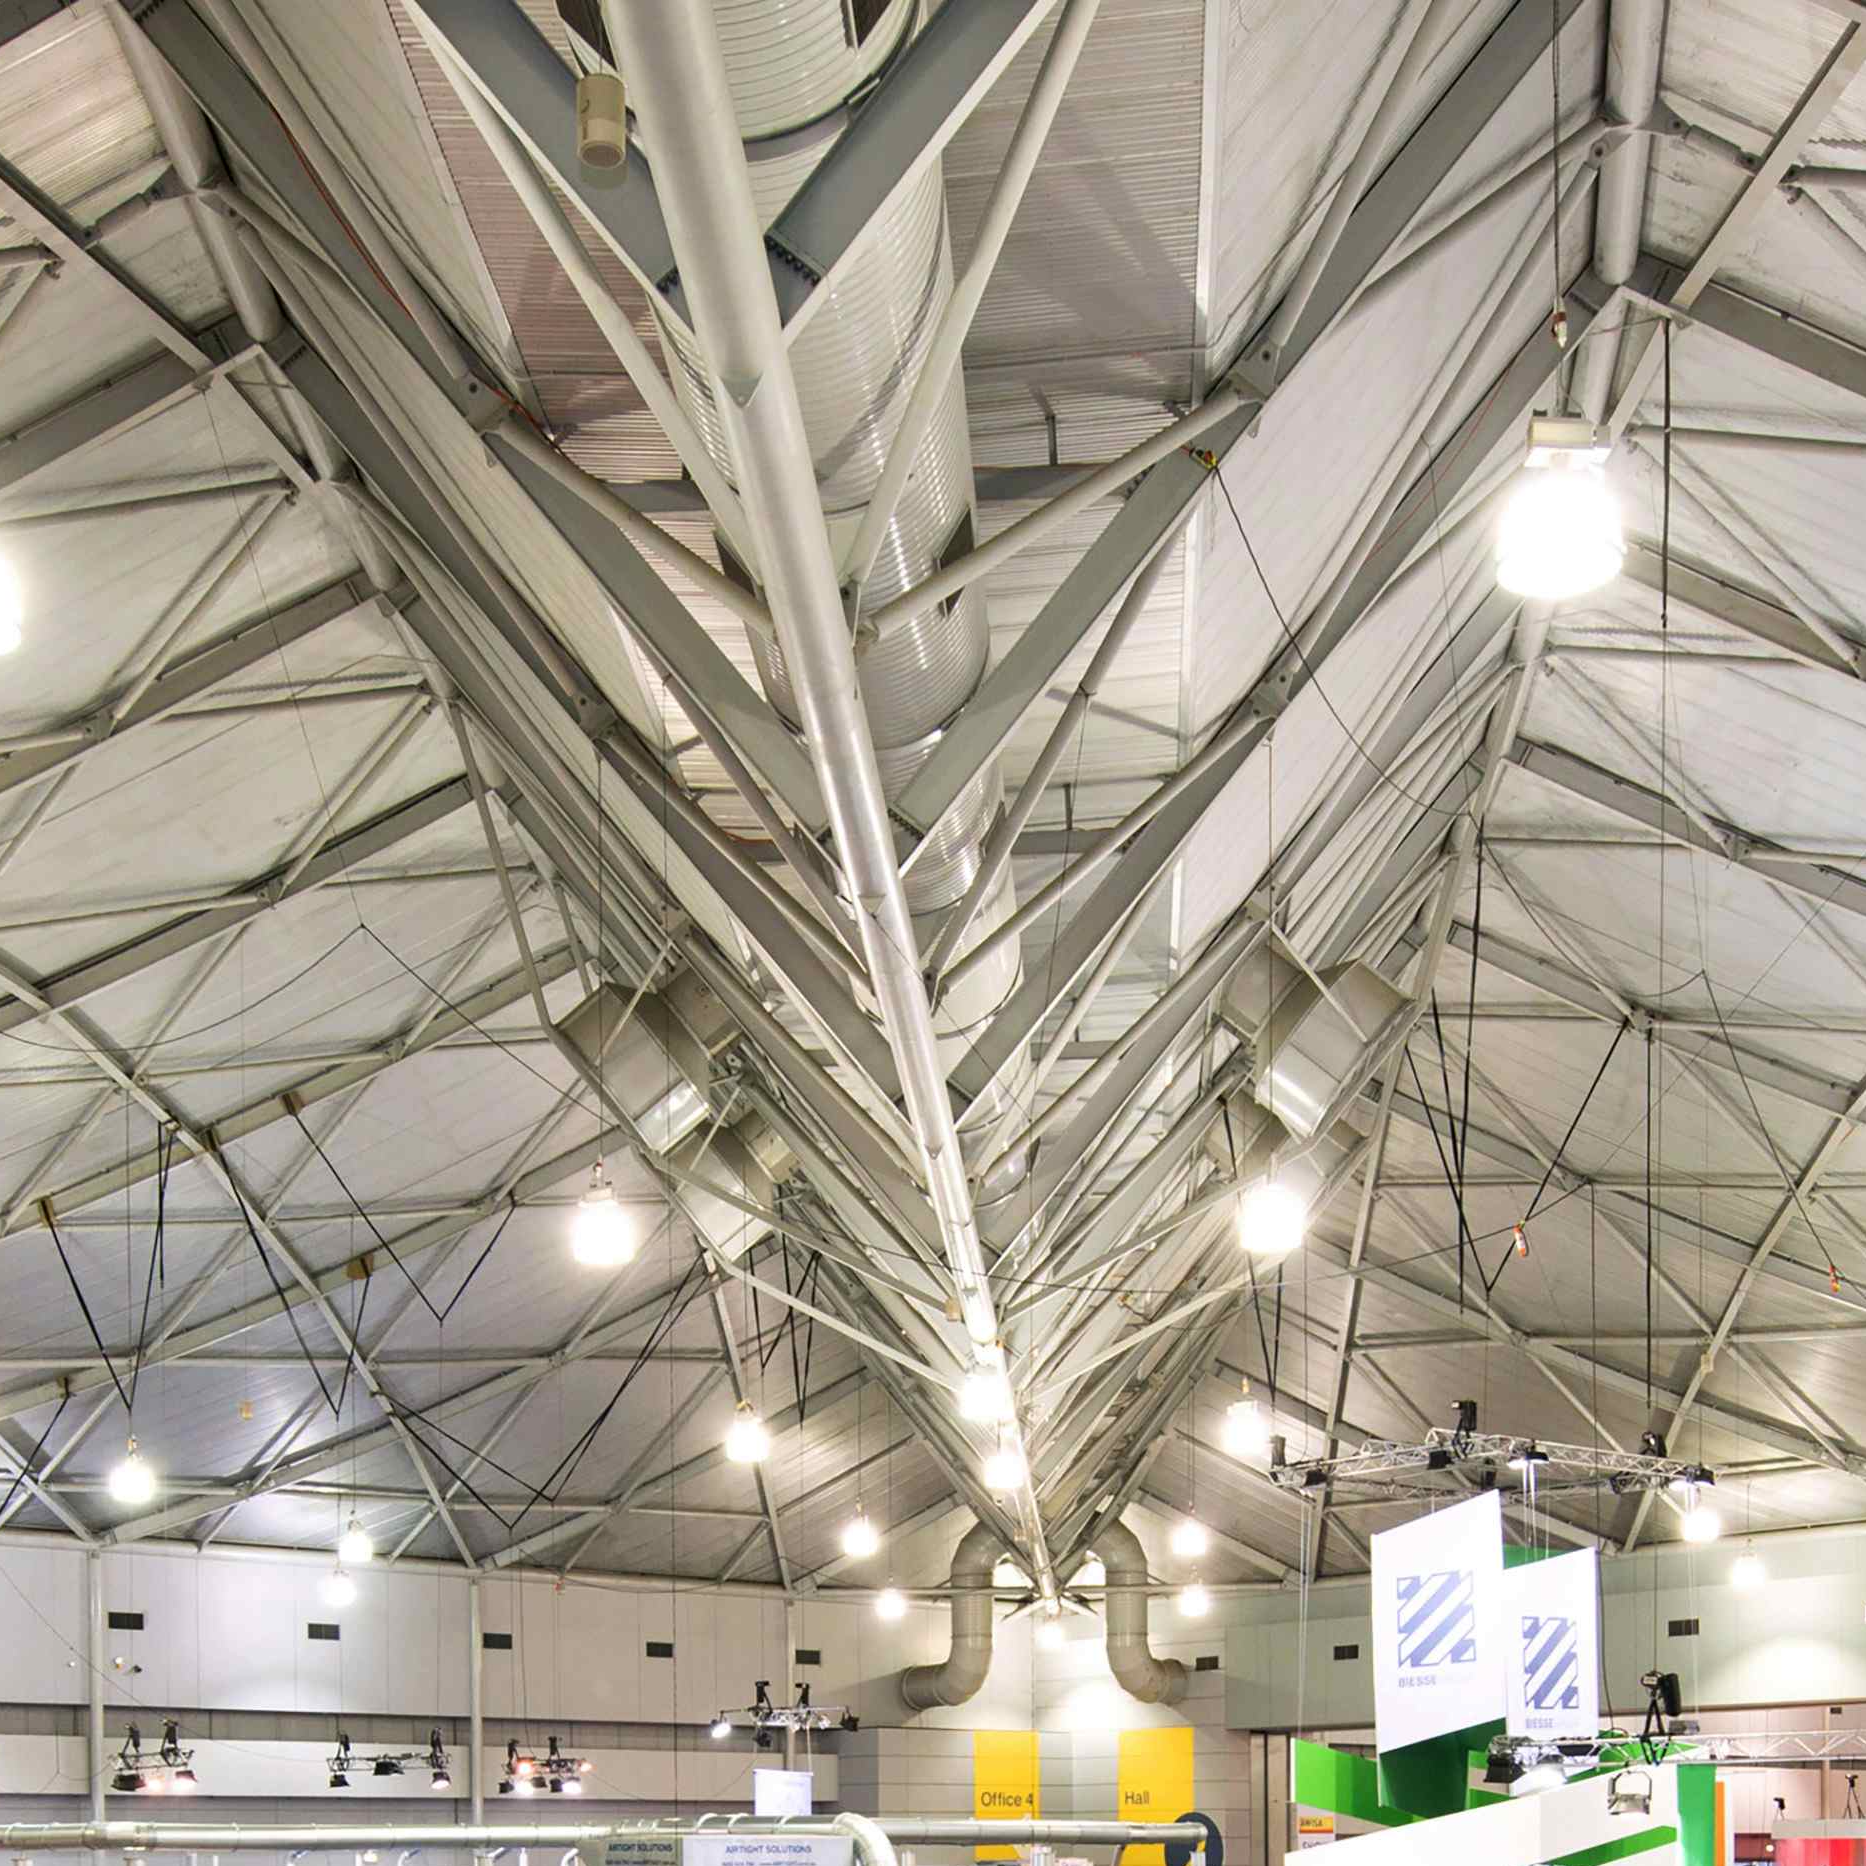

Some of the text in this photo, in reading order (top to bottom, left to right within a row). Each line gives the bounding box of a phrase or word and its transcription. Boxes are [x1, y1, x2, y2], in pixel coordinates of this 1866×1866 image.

[980, 1791, 1034, 1807] Office 4
[1124, 1790, 1150, 1805] Hall
[725, 1844, 812, 1855] AIRTIGHT SOLUTIONS
